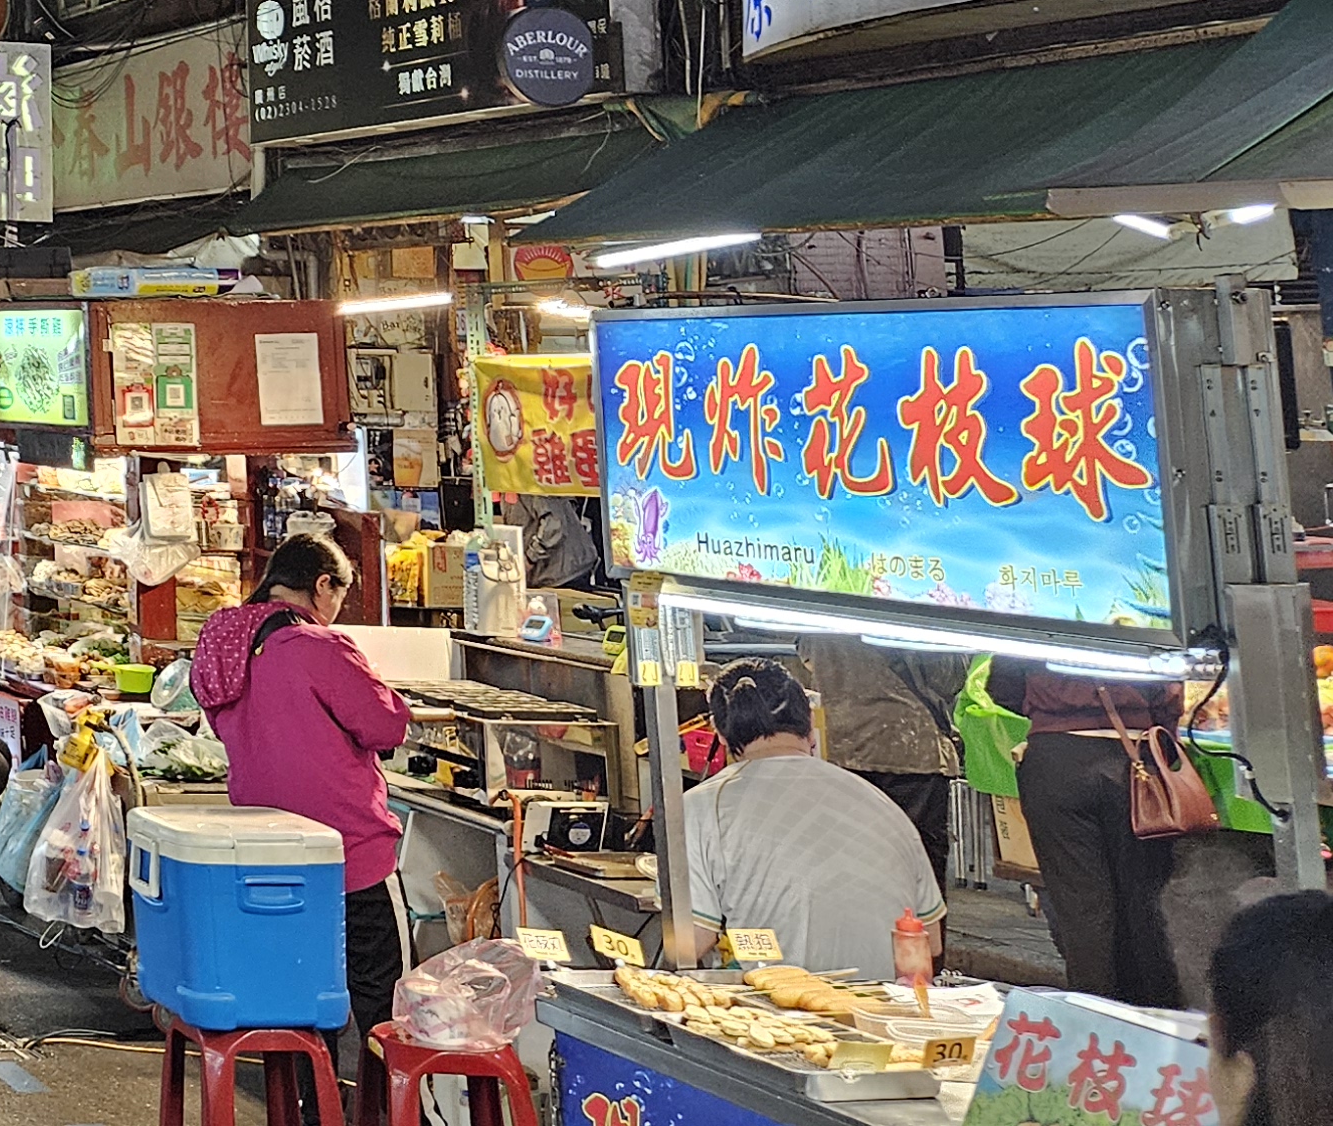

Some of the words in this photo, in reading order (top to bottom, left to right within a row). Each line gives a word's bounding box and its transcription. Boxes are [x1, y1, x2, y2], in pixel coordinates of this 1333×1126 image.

[291, 30, 334, 72] 菸酒
[505, 30, 590, 60] ABERLOUR
[515, 68, 579, 80] DISTILLERY
[53, 52, 252, 177] 春山銀樓
[614, 335, 1153, 524] 現炸花枝球
[696, 530, 816, 566] Huazhimaru
[871, 551, 946, 582] はのまる
[999, 564, 1084, 598] 화지마루
